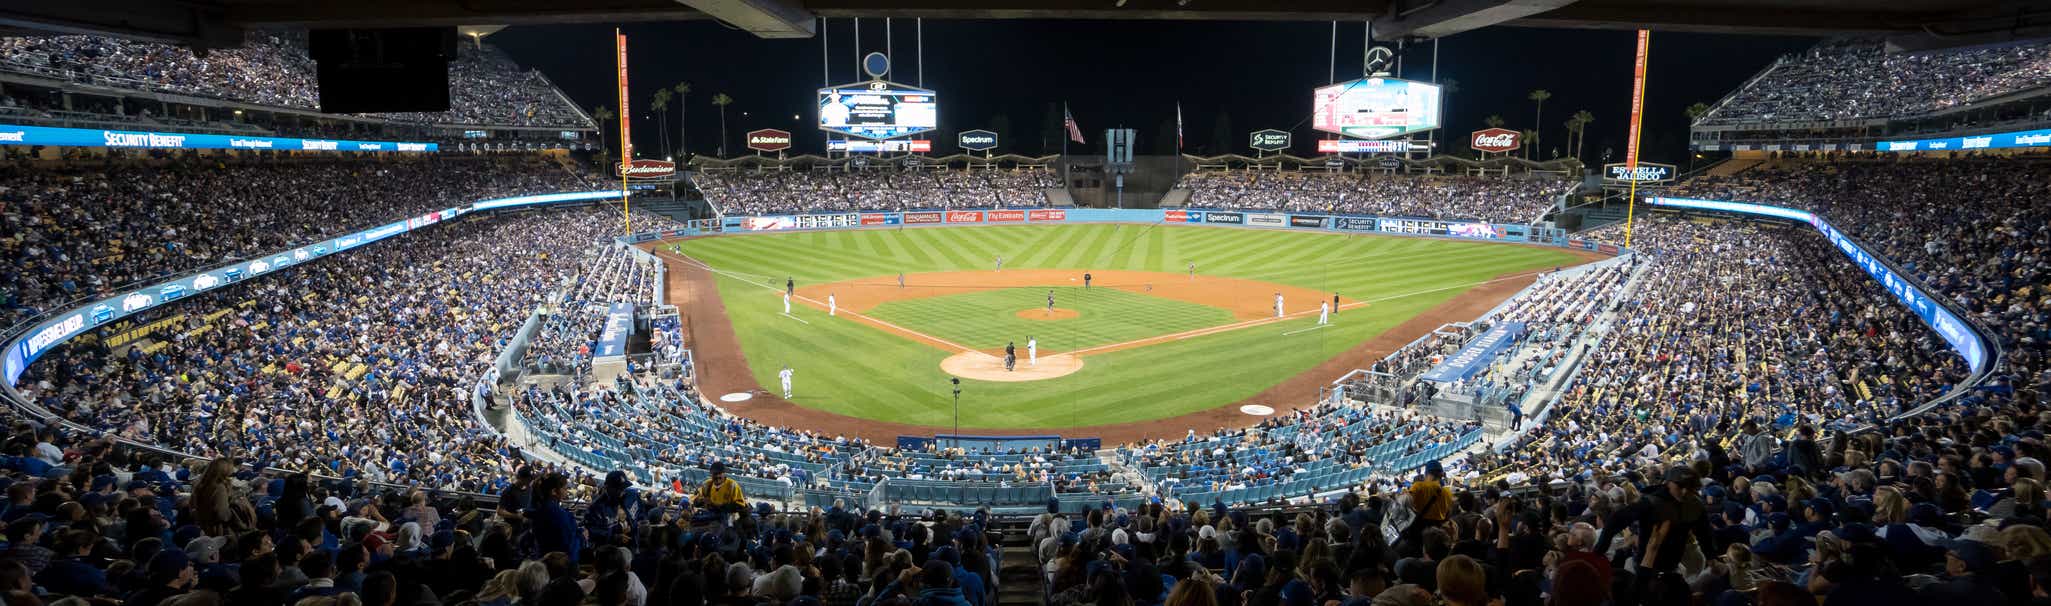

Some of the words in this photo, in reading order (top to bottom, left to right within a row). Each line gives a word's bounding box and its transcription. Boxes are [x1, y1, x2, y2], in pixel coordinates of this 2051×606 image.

[104, 130, 148, 146] SECURITY
[962, 136, 992, 144] Spectrum
[618, 164, 673, 174] Budweiser
[1208, 214, 1240, 222] Spectrum
